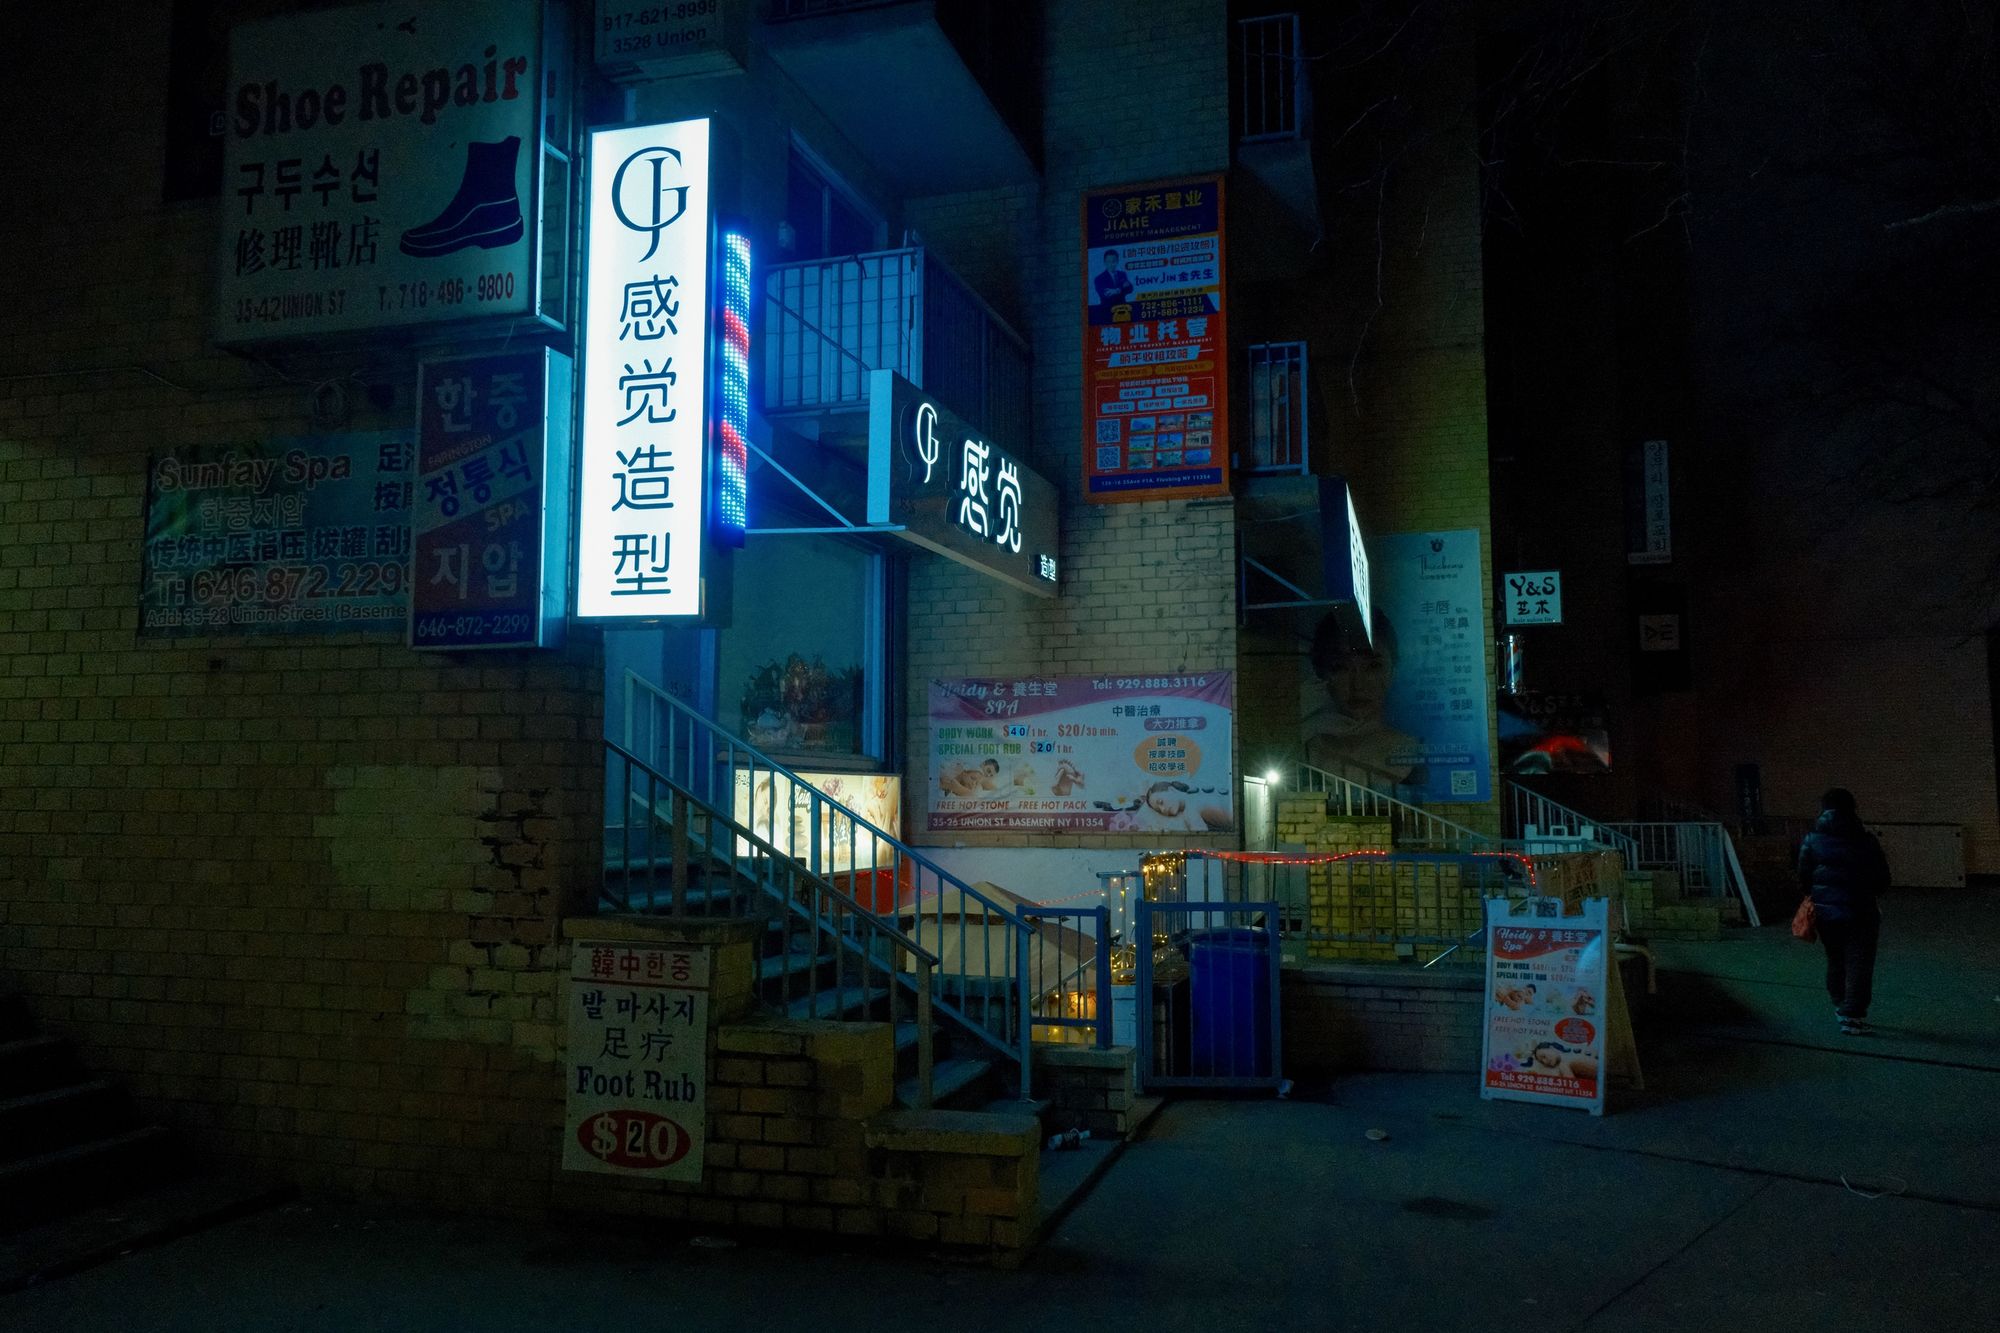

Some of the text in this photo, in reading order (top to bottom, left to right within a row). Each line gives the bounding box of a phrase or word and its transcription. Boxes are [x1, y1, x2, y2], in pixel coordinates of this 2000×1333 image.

[656, 28, 706, 46] Union
[235, 45, 527, 138] Shoe Repair
[237, 149, 380, 214] 구두수선
[1125, 190, 1203, 215] 家禾置业
[1104, 216, 1150, 231] JIAHE
[1147, 224, 1201, 235] MANAGEMENT
[235, 216, 381, 277] 修理靴店
[1178, 268, 1214, 282] 金先生
[328, 289, 346, 315] ST
[434, 372, 529, 433] 한중
[610, 273, 681, 597] 感觉造型
[157, 449, 352, 494] Sunfay Spa
[424, 439, 532, 517] 정통식
[960, 439, 1022, 553] 感觉
[484, 499, 532, 533] SPA
[430, 541, 524, 600] 지압
[1510, 575, 1556, 596] Y&S
[230, 605, 278, 623] Union
[278, 604, 332, 621] Street
[333, 603, 408, 622] (Baseme
[1516, 600, 1550, 615] 艺术
[417, 614, 530, 638] 646-872-2299
[993, 682, 1006, 696] &
[1012, 681, 1058, 697] 養生堂
[1092, 677, 1206, 690] Tel: 929.888.3116
[985, 699, 1019, 716] SPA
[1112, 705, 1161, 717] 中醫治療
[938, 727, 963, 739] BODY
[966, 727, 994, 739] WORK
[938, 743, 975, 755] SPECIAL
[977, 743, 1001, 755] FOOT
[1003, 743, 1022, 754] RUB
[936, 801, 1087, 810] FREE HOT STONE FREE HOT PACK
[960, 817, 992, 827] UNION
[1009, 817, 1055, 827] BASEMENT
[1057, 817, 1071, 826] NY
[1075, 818, 1104, 827] 11354
[1502, 940, 1524, 953] Spa
[582, 990, 695, 1026] 발 마사지
[599, 1027, 674, 1063] 足疗
[576, 1065, 696, 1103] Foot Rub
[1517, 1074, 1580, 1089] 929.888.3116
[591, 1112, 678, 1162] $20
